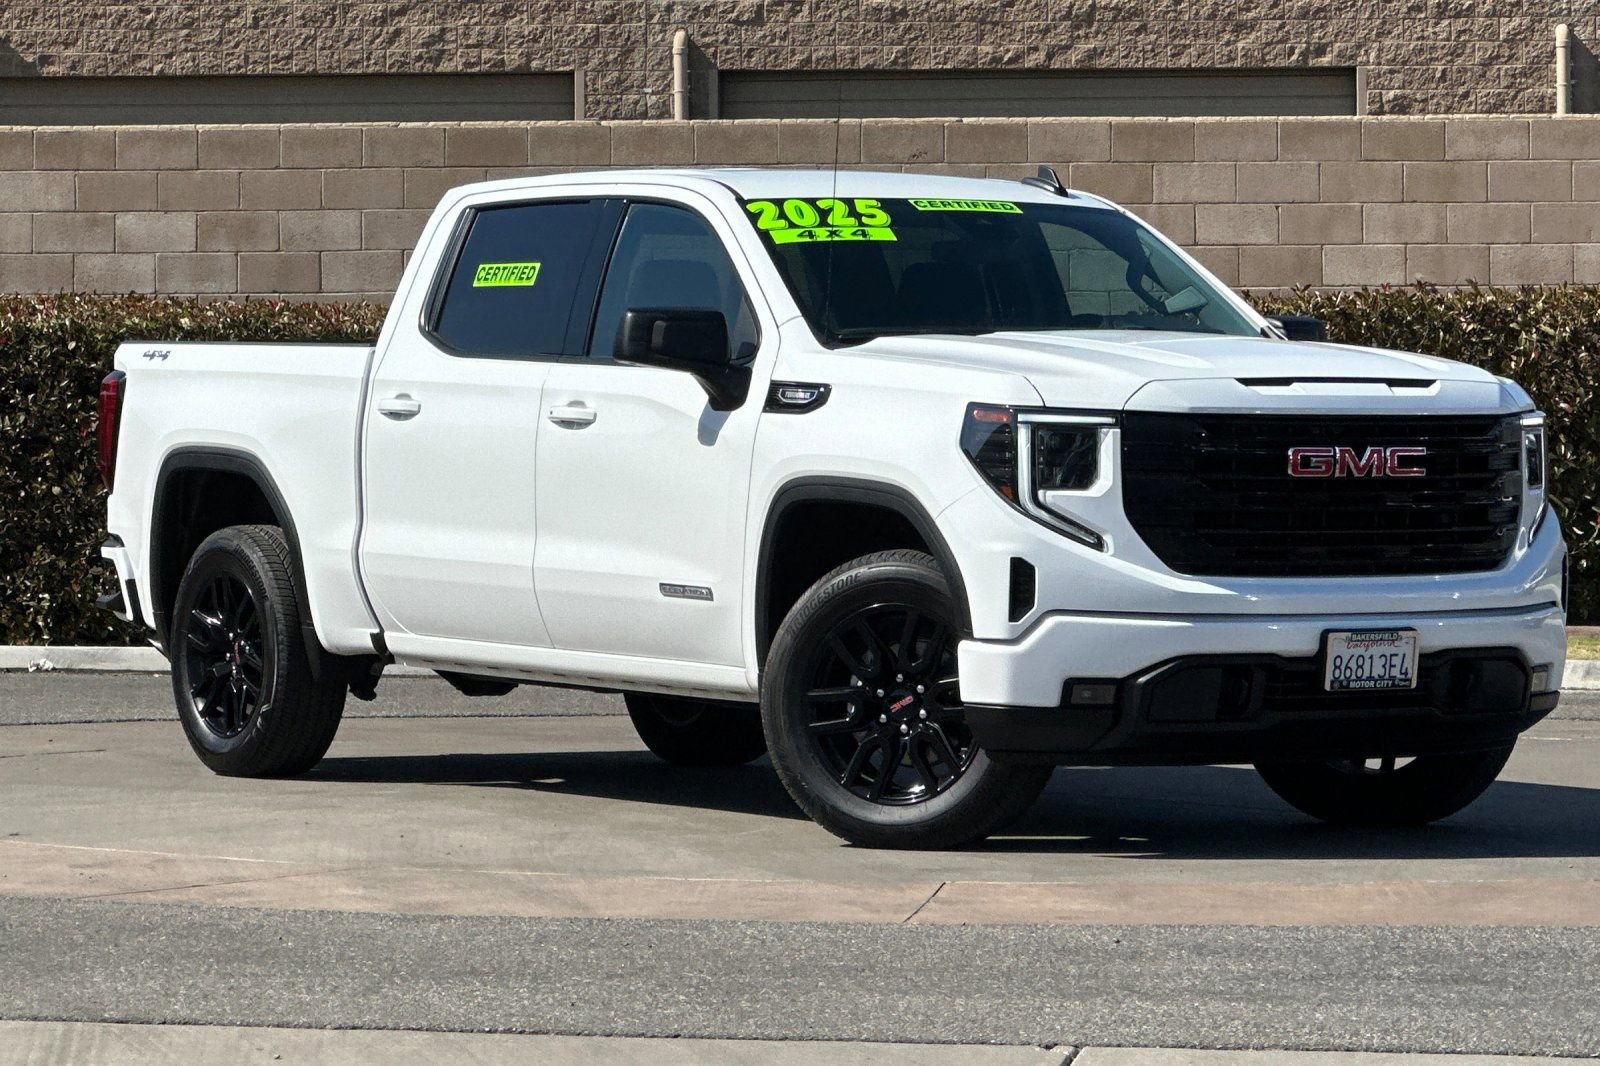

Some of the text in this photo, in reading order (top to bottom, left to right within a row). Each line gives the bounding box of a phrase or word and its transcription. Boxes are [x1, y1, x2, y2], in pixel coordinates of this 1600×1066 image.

[912, 199, 1015, 212] CERTIFIED
[746, 199, 892, 230] 2025
[476, 265, 537, 282] CERTIFIED
[1287, 446, 1427, 478] GMC
[1351, 632, 1399, 641] BAKERSFIELD
[1332, 653, 1409, 680] 86813E4
[1376, 680, 1393, 688] CITY
